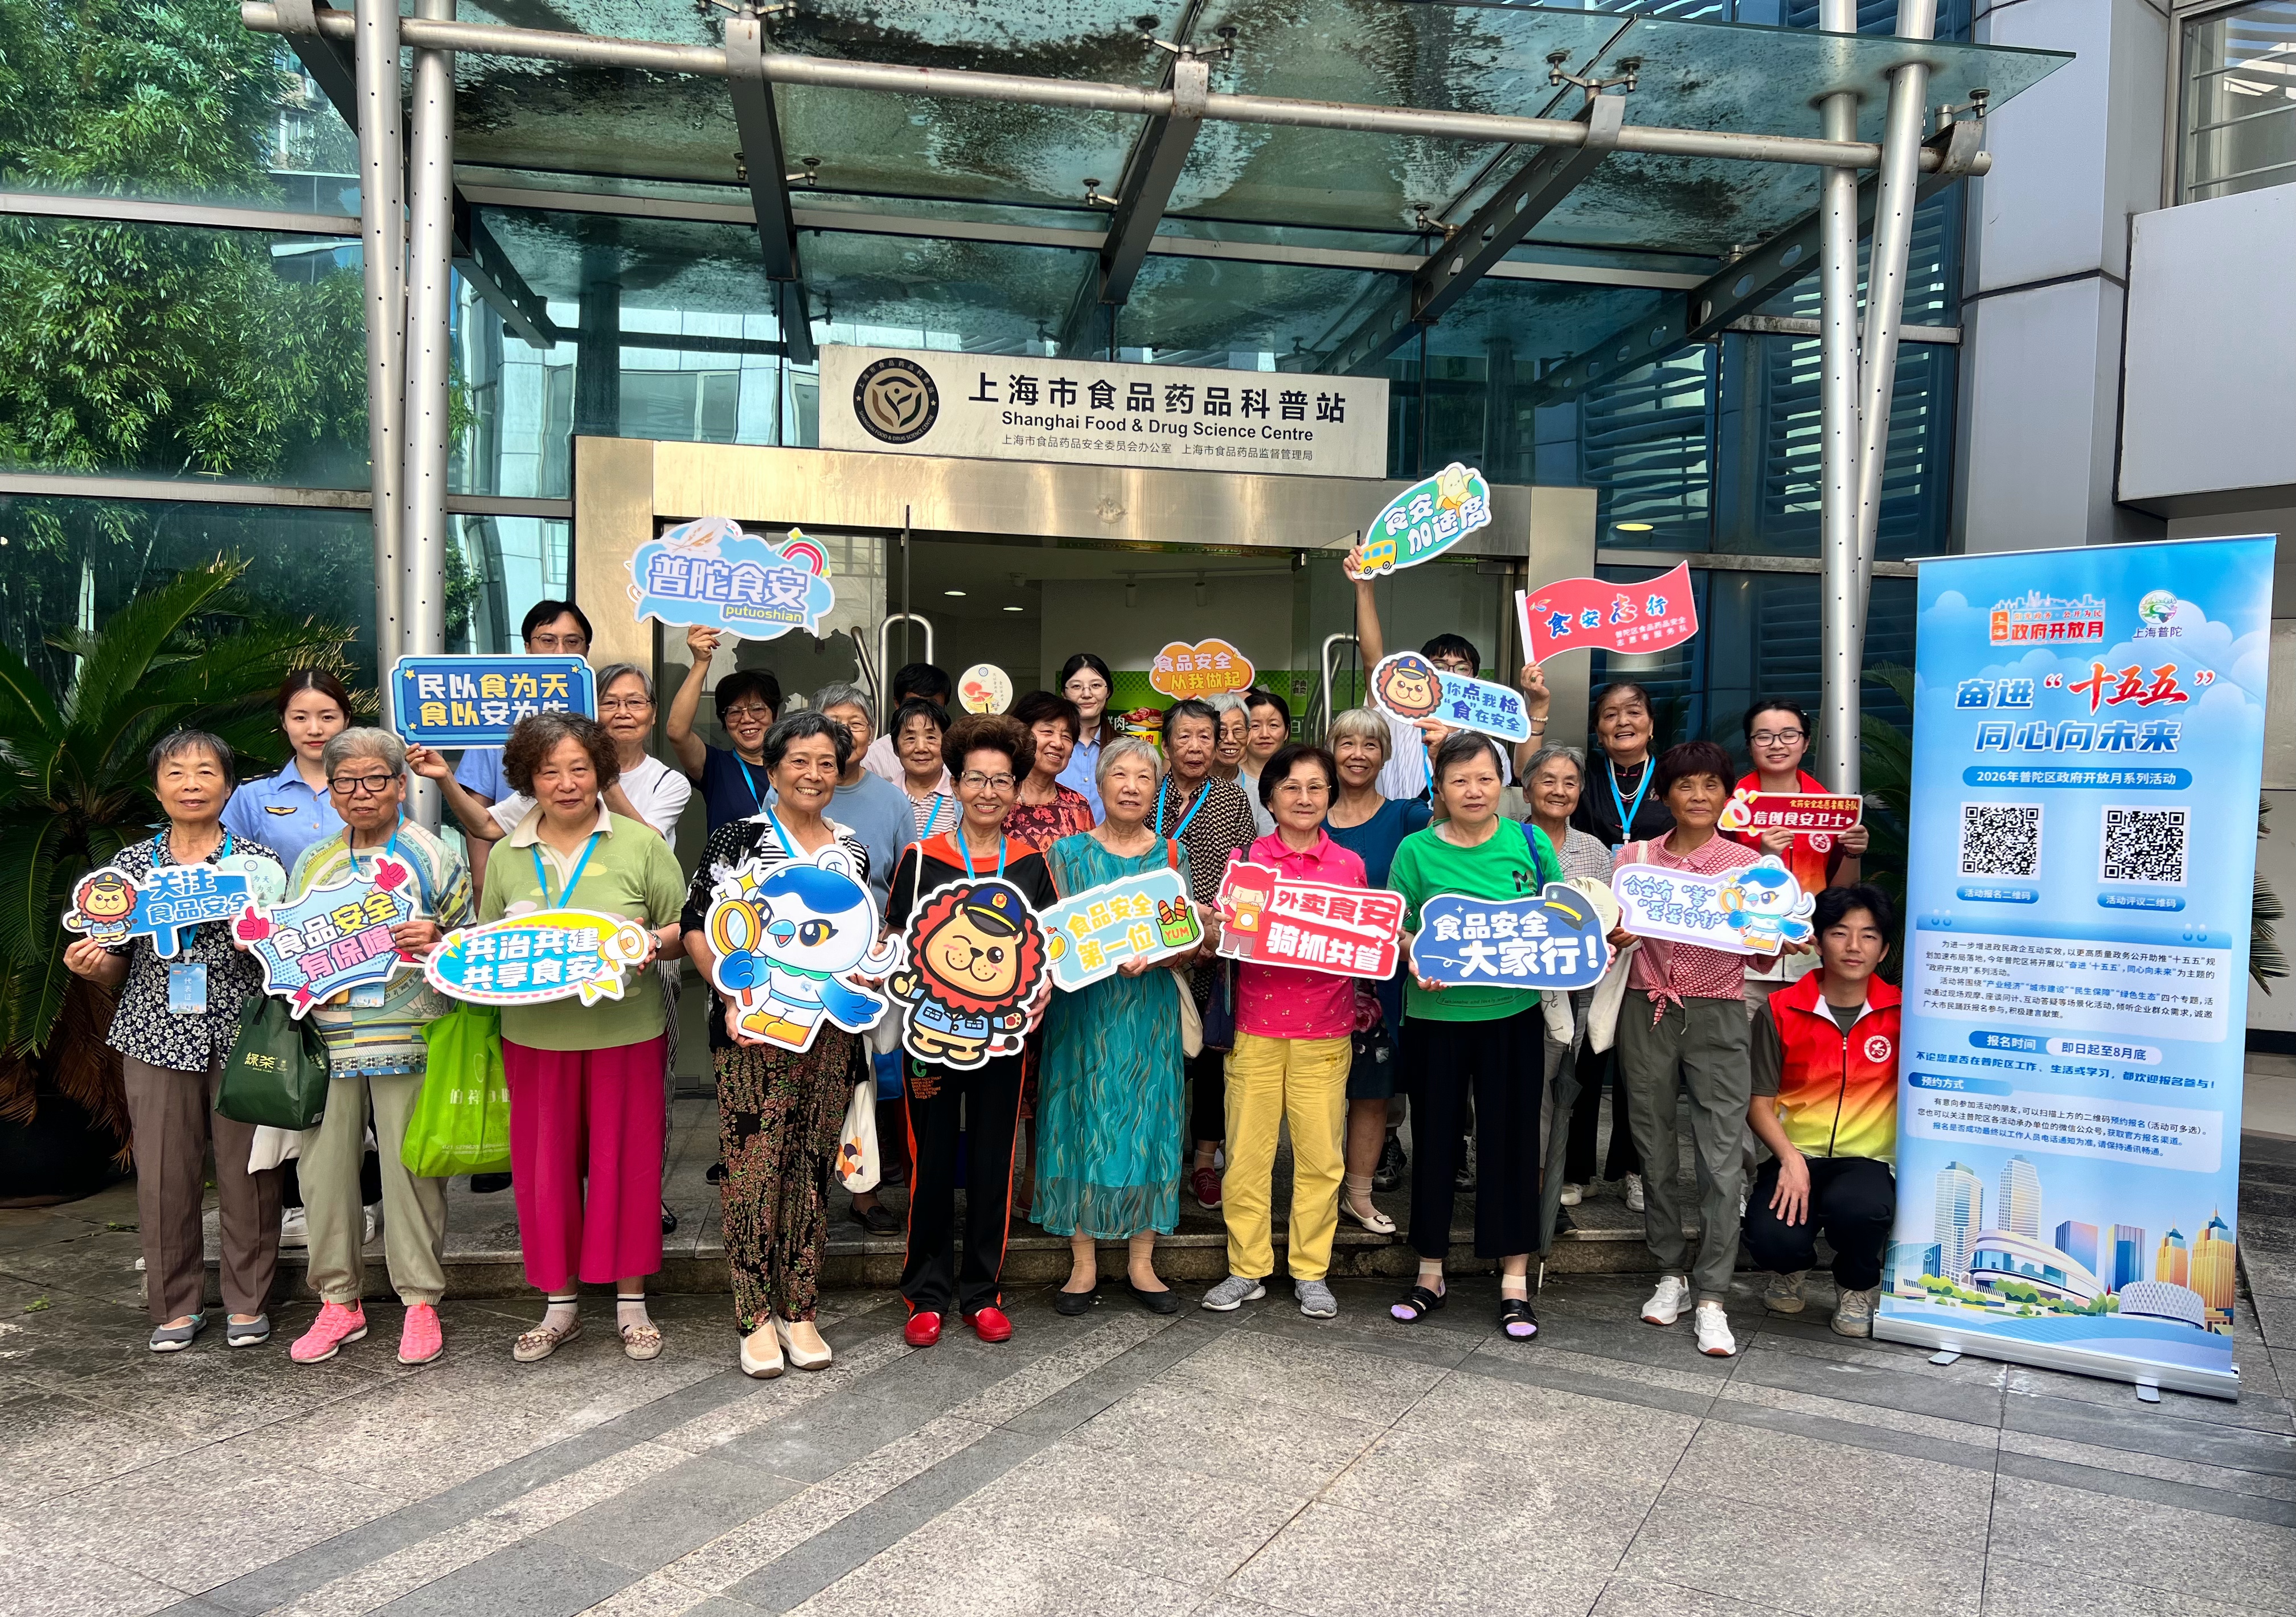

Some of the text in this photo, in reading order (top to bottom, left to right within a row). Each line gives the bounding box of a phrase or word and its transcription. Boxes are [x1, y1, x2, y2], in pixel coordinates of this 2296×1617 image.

[969, 371, 1346, 424] 上海市食品药品科普站
[1002, 411, 1314, 442] Shanghai Food & Drug Science Centre
[1002, 434, 1314, 462] 上海市食品药品安全委员会办公室 上海市食品药品监督管理局
[1384, 493, 1434, 537] 食安
[1407, 495, 1489, 555] 加速度
[649, 554, 809, 609] 普陀食安
[725, 605, 803, 623] putuoshian
[1615, 616, 1687, 639] 普陀区食品药品安全
[1617, 625, 1688, 647] 志愿者服务队
[2011, 621, 2104, 640] 政府开放月
[2133, 626, 2183, 638] 上海普陀
[1155, 652, 1232, 672] 食品安全
[419, 673, 569, 699] 民以食为天
[1170, 670, 1241, 691] 从我做起
[1444, 697, 1522, 733] “食”在安全
[1446, 683, 1520, 715] 你点我检
[1974, 720, 2183, 753] 同心向未来
[1977, 770, 2176, 786] 2026年普陀区政府开放月系列活动
[147, 868, 218, 900] 关注
[1965, 888, 2031, 900] 活动报名二维码
[146, 892, 252, 926] 食品安全
[1067, 889, 1155, 940] 食品安全
[1276, 890, 1396, 933] 外卖食安
[2106, 894, 2176, 908] 活动评议二维码
[270, 889, 399, 959] 食品安全
[1165, 926, 1190, 941] YUM
[1432, 909, 1549, 942] 食品安全
[297, 924, 397, 981] 有保障
[464, 926, 600, 963] 共治共建
[1077, 922, 1157, 972] 第一位
[1266, 921, 1383, 972] 骑抓共管
[1459, 934, 1597, 978] 大家行！
[461, 955, 599, 992] 共享食安
[1987, 1035, 2147, 1061] 报名时间 即日起至8月底
[1921, 1076, 1965, 1090] 预约方式
